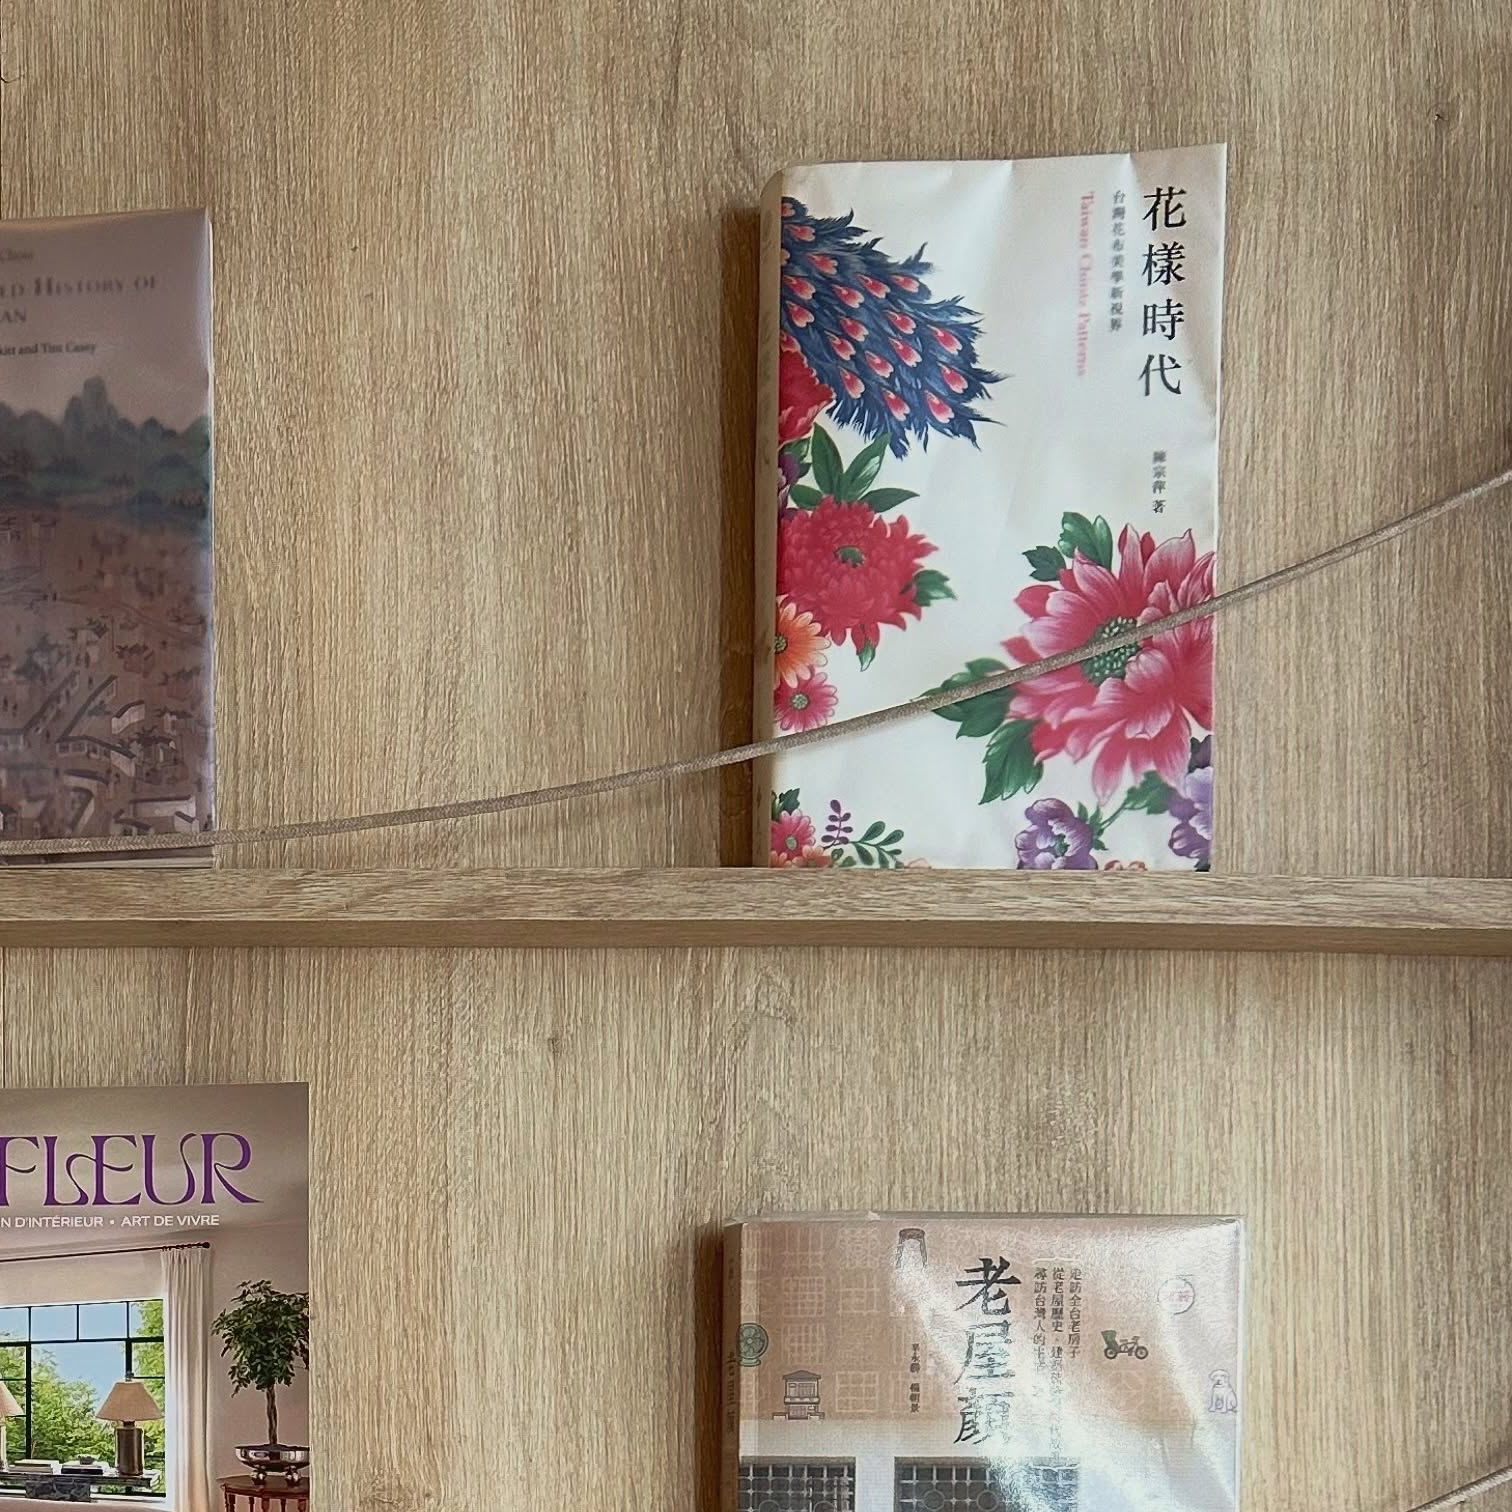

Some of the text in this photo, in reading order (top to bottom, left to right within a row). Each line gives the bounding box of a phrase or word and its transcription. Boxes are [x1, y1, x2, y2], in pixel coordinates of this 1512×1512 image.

[1138, 186, 1187, 397] 花樣時代
[19, 343, 39, 356] and
[14, 1213, 104, 1229] D'INTÉRIEUR
[121, 1216, 150, 1227] ART
[153, 1215, 174, 1226] DE
[177, 1214, 220, 1226] VIVRE
